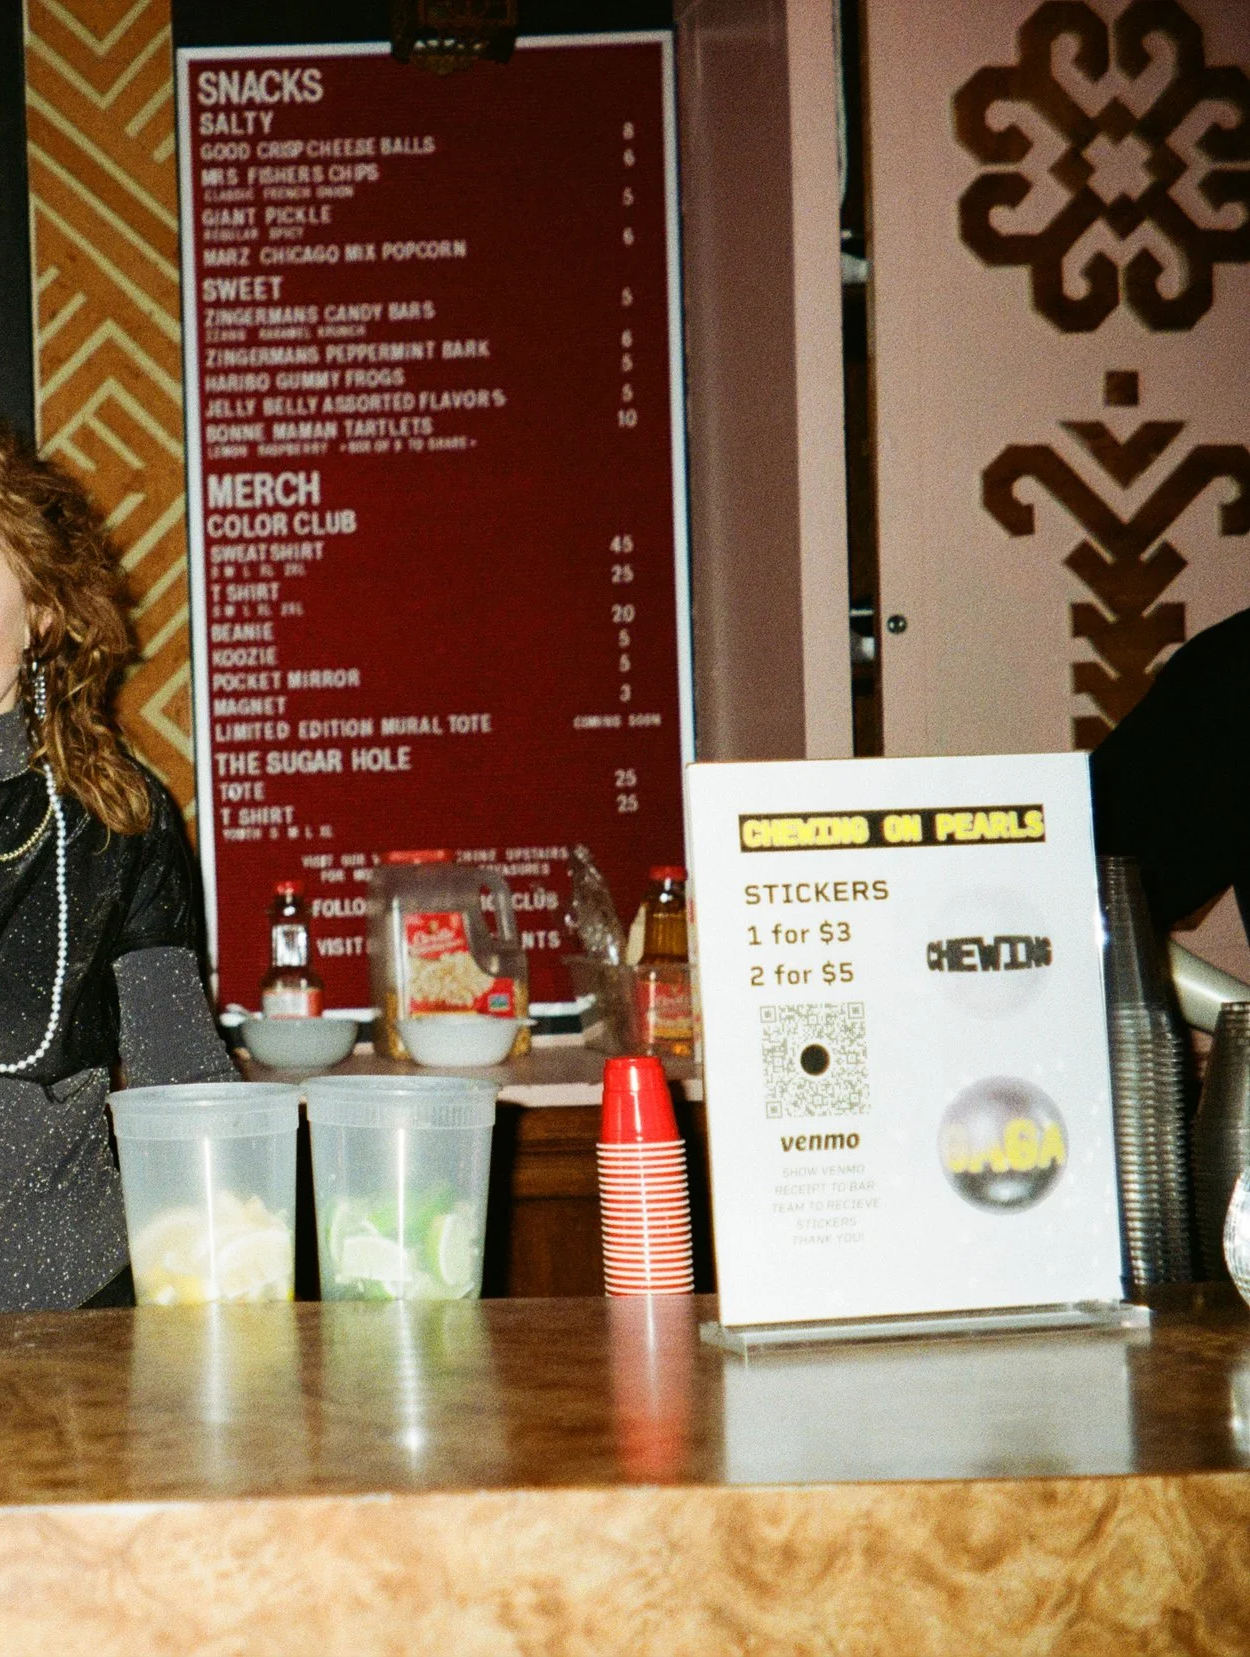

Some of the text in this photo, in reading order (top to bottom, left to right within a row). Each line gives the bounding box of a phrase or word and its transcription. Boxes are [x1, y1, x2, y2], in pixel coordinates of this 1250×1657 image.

[198, 68, 324, 105] SNACKS
[199, 110, 274, 136] SALTY
[200, 142, 250, 161] GOOD
[306, 137, 377, 158] CHEESE
[379, 135, 436, 155] BALLS
[201, 204, 332, 227] GIANT PICKLE
[203, 239, 468, 267] MARZ CHICAGO MIX POPCORN
[203, 275, 283, 301] SWEET
[205, 300, 436, 328] ZINGERMANS CANDY BARS
[205, 339, 490, 369] ZINGERMANS PEPPERMINT BARK
[205, 367, 406, 393] HARIBO GUMMY FROGS
[205, 388, 507, 419] JELLY BELLY ASSORTED FLAVORS
[617, 407, 638, 428] 10
[206, 416, 434, 444] BONNE MAMAN TARTLETS
[207, 470, 321, 509] MERCH
[207, 509, 357, 538] COLOR CLUB
[609, 534, 634, 553] 45
[611, 564, 634, 584] 25
[211, 581, 280, 603] T SHIRT
[611, 604, 635, 623] 20
[211, 622, 273, 643] BEANIE
[212, 645, 278, 667] KOOZIE
[213, 668, 361, 692] POCKET MIRROR
[620, 683, 631, 702] 3
[214, 696, 287, 717] MAGNET
[215, 713, 492, 743] LIMITED EDITION MURAL TOTE
[215, 745, 413, 777] THE SUGAR HOLE
[614, 768, 637, 788] 25
[220, 781, 265, 802] TOTE
[617, 793, 639, 813] 25
[220, 805, 295, 827] T SHIRT
[741, 810, 1044, 848] CHEWING ON PEARLS
[510, 890, 559, 911] CLUB
[745, 880, 890, 905] STICKERS
[748, 920, 852, 946] 1 for $3
[316, 936, 363, 956] VISIT
[926, 935, 1053, 973] CHEWING
[751, 961, 854, 986] 2 for $5
[780, 1130, 860, 1152] venmo
[782, 1163, 865, 1178] SHOW VENMO
[774, 1180, 876, 1195] RECEIPT TO BAR
[772, 1201, 805, 1213] TEAM
[809, 1200, 824, 1211] TO
[796, 1216, 857, 1229] STICKERS
[792, 1234, 832, 1246] THANK
